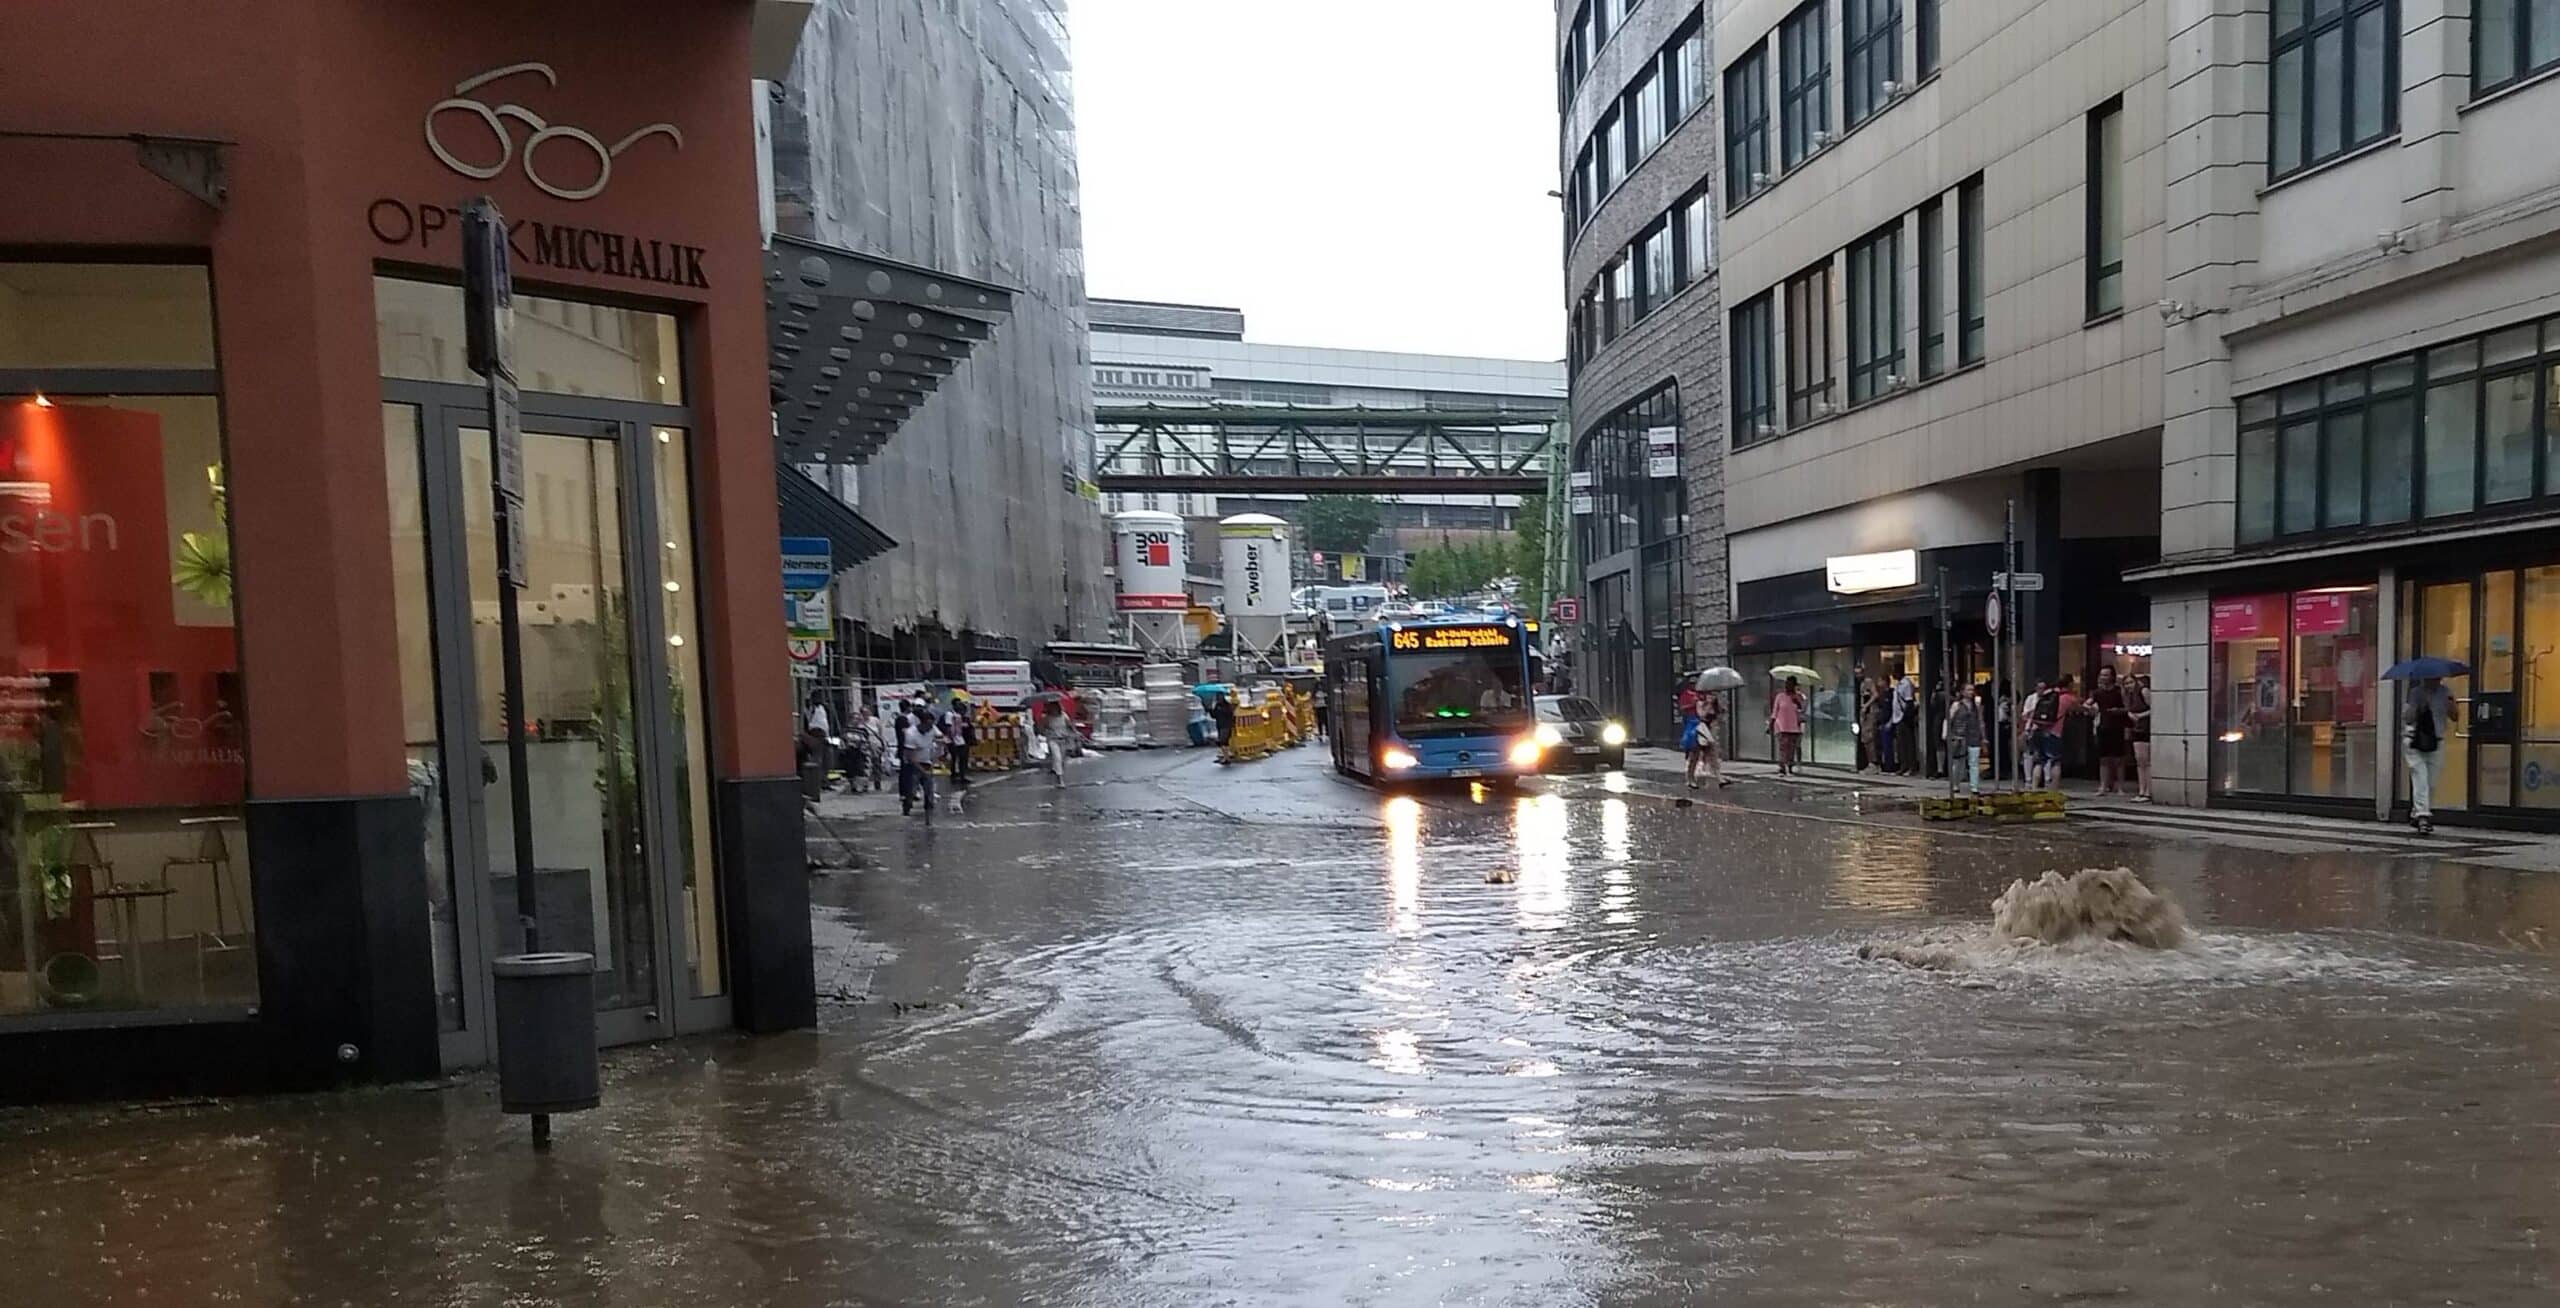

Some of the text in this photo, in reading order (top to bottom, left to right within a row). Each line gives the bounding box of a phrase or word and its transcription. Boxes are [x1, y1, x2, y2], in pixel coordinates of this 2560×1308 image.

[532, 221, 711, 289] MICHALIK
[783, 558, 829, 570] Hermes
[1245, 543, 1260, 595] weber
[1393, 631, 1419, 649] 645
